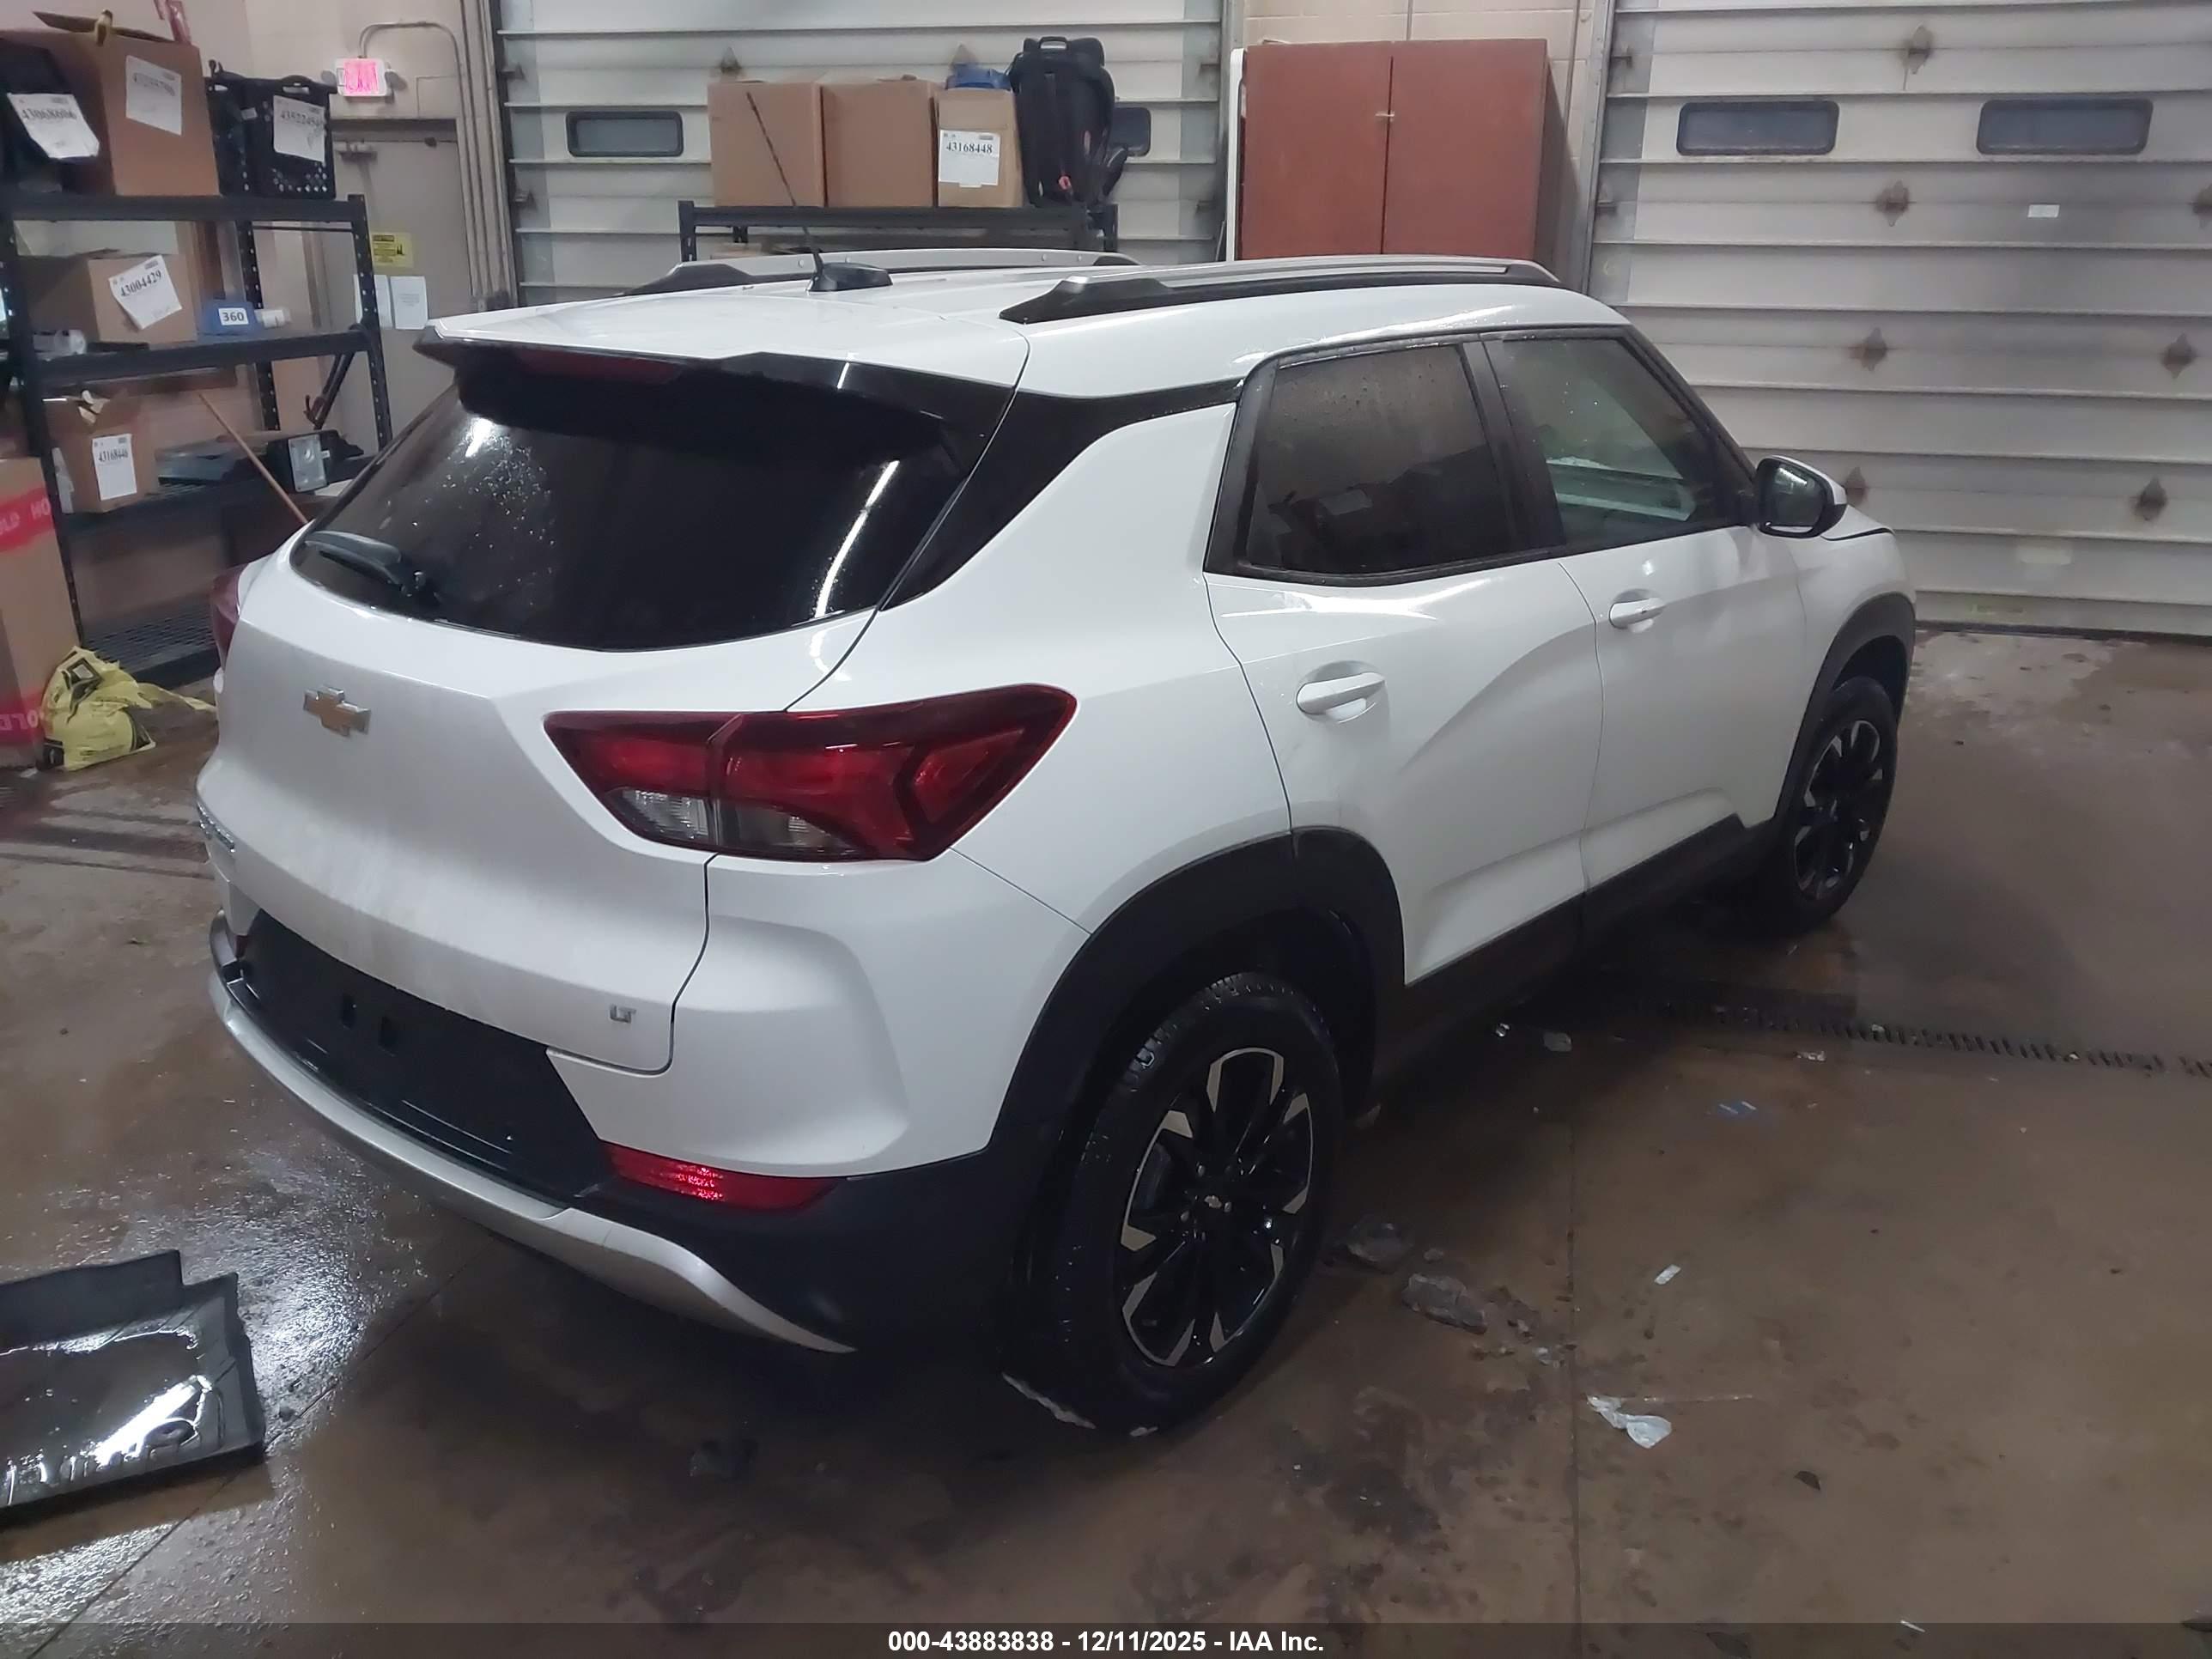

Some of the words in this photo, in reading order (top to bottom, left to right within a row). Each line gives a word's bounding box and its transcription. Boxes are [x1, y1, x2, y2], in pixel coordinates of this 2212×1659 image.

[946, 142, 993, 154] 43168448
[121, 270, 161, 296] 43004429
[222, 312, 245, 322] 360
[610, 1005, 637, 1024] LT
